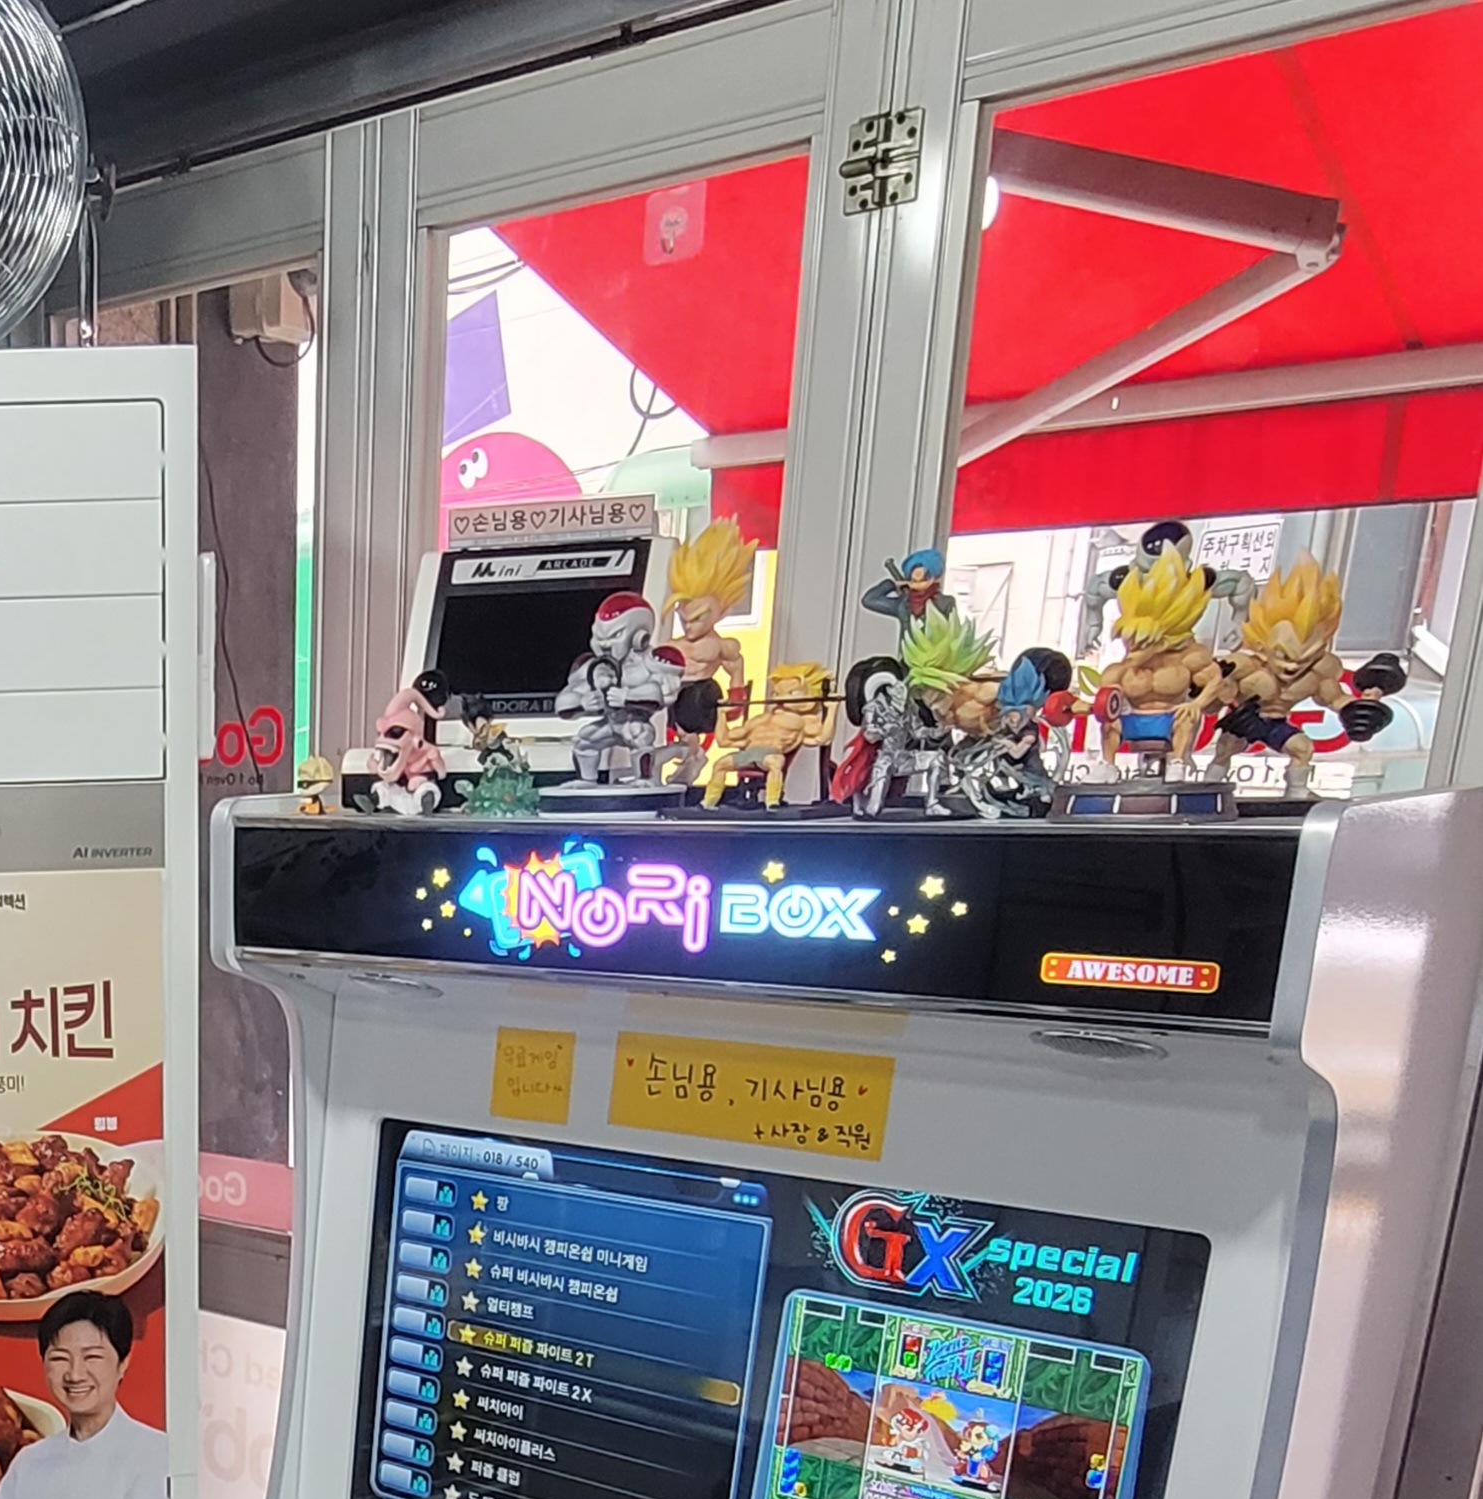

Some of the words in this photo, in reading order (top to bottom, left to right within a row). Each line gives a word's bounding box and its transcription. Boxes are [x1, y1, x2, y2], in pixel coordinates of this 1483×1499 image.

[471, 509, 528, 533] 손님용
[549, 502, 627, 528] 기사님용
[471, 562, 523, 579] Mini
[544, 557, 596, 570] ARCADE
[72, 846, 89, 859] AI
[90, 846, 154, 860] INVERTER
[719, 883, 883, 943] BOX
[1066, 959, 1195, 986] AWESOME
[10, 980, 115, 1060] 치킨
[745, 1075, 847, 1112] 기사님용
[770, 1122, 810, 1145] 사장
[833, 1122, 871, 1150] 직원
[483, 1150, 503, 1165] 018
[515, 1155, 539, 1170] 540
[492, 1229, 541, 1255] 비시바시
[596, 1248, 649, 1273] 미니게임
[986, 1236, 1140, 1285] special
[489, 1263, 514, 1282] 슈퍼
[516, 1269, 565, 1296] 비시바시
[1012, 1275, 1095, 1316] 2026
[483, 1330, 507, 1349] 슈퍼
[509, 1336, 535, 1355] 퍼즐
[536, 1341, 574, 1363] 파이트
[480, 1363, 504, 1383] 슈퍼
[506, 1368, 531, 1389] 퍼즐
[532, 1374, 570, 1397] 파이트
[470, 1459, 495, 1479] 퍼즐
[869, 1479, 898, 1495] SCORE
